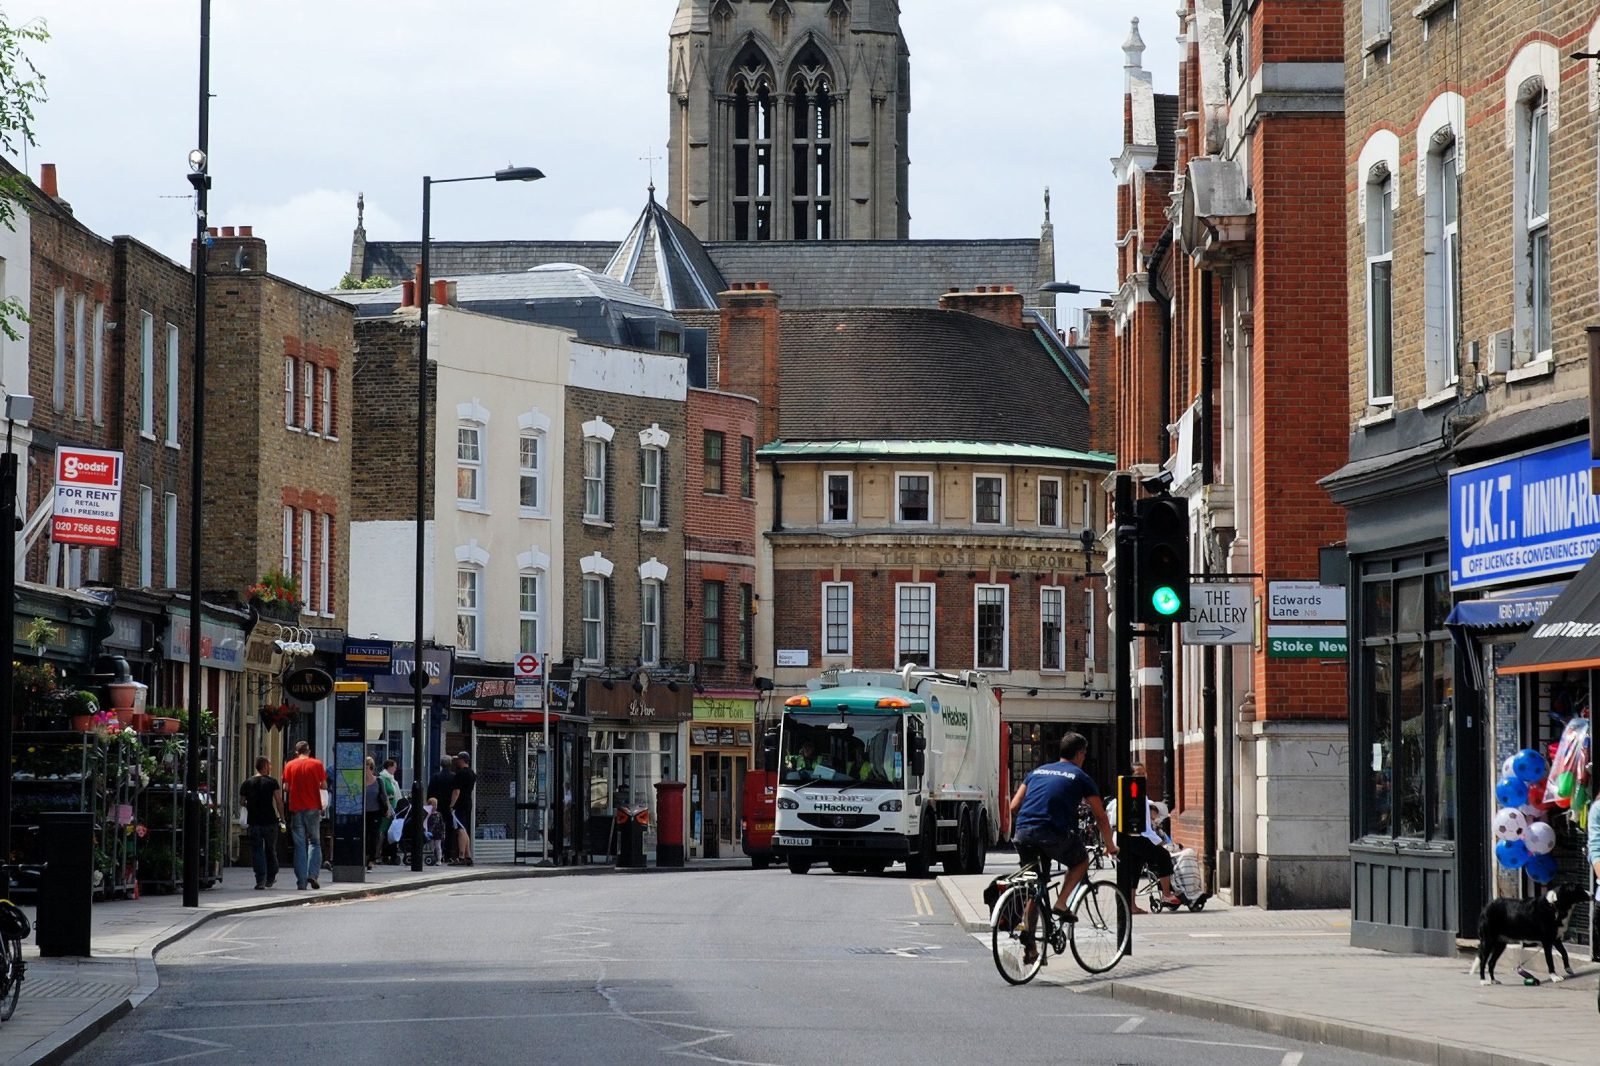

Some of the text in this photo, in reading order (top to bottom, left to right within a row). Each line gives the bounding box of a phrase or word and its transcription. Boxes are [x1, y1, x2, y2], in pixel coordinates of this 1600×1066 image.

[64, 457, 109, 478] goodsir
[59, 488, 118, 501] FOR RENT
[75, 499, 100, 507] RETAIL
[1523, 469, 1600, 538] MINIMARK
[78, 509, 114, 517] PREMISES
[55, 521, 117, 535] 020 7566 6455
[882, 551, 1073, 569] THE ROSE AND CROWN
[1470, 557, 1484, 573] OFF
[1484, 553, 1514, 570] LICENCE
[1515, 554, 1522, 565] &
[1523, 542, 1578, 564] CONVENIENCE
[1205, 590, 1231, 606] THE
[1273, 595, 1322, 605] Edwards
[1189, 607, 1248, 623] GALLERY
[1273, 606, 1299, 617] Lane
[349, 647, 388, 655] HUNTERS
[1273, 640, 1313, 652] Stoke
[629, 700, 639, 716] Le
[1032, 769, 1076, 780] MONTCLAIR
[823, 803, 864, 814] Hackney
